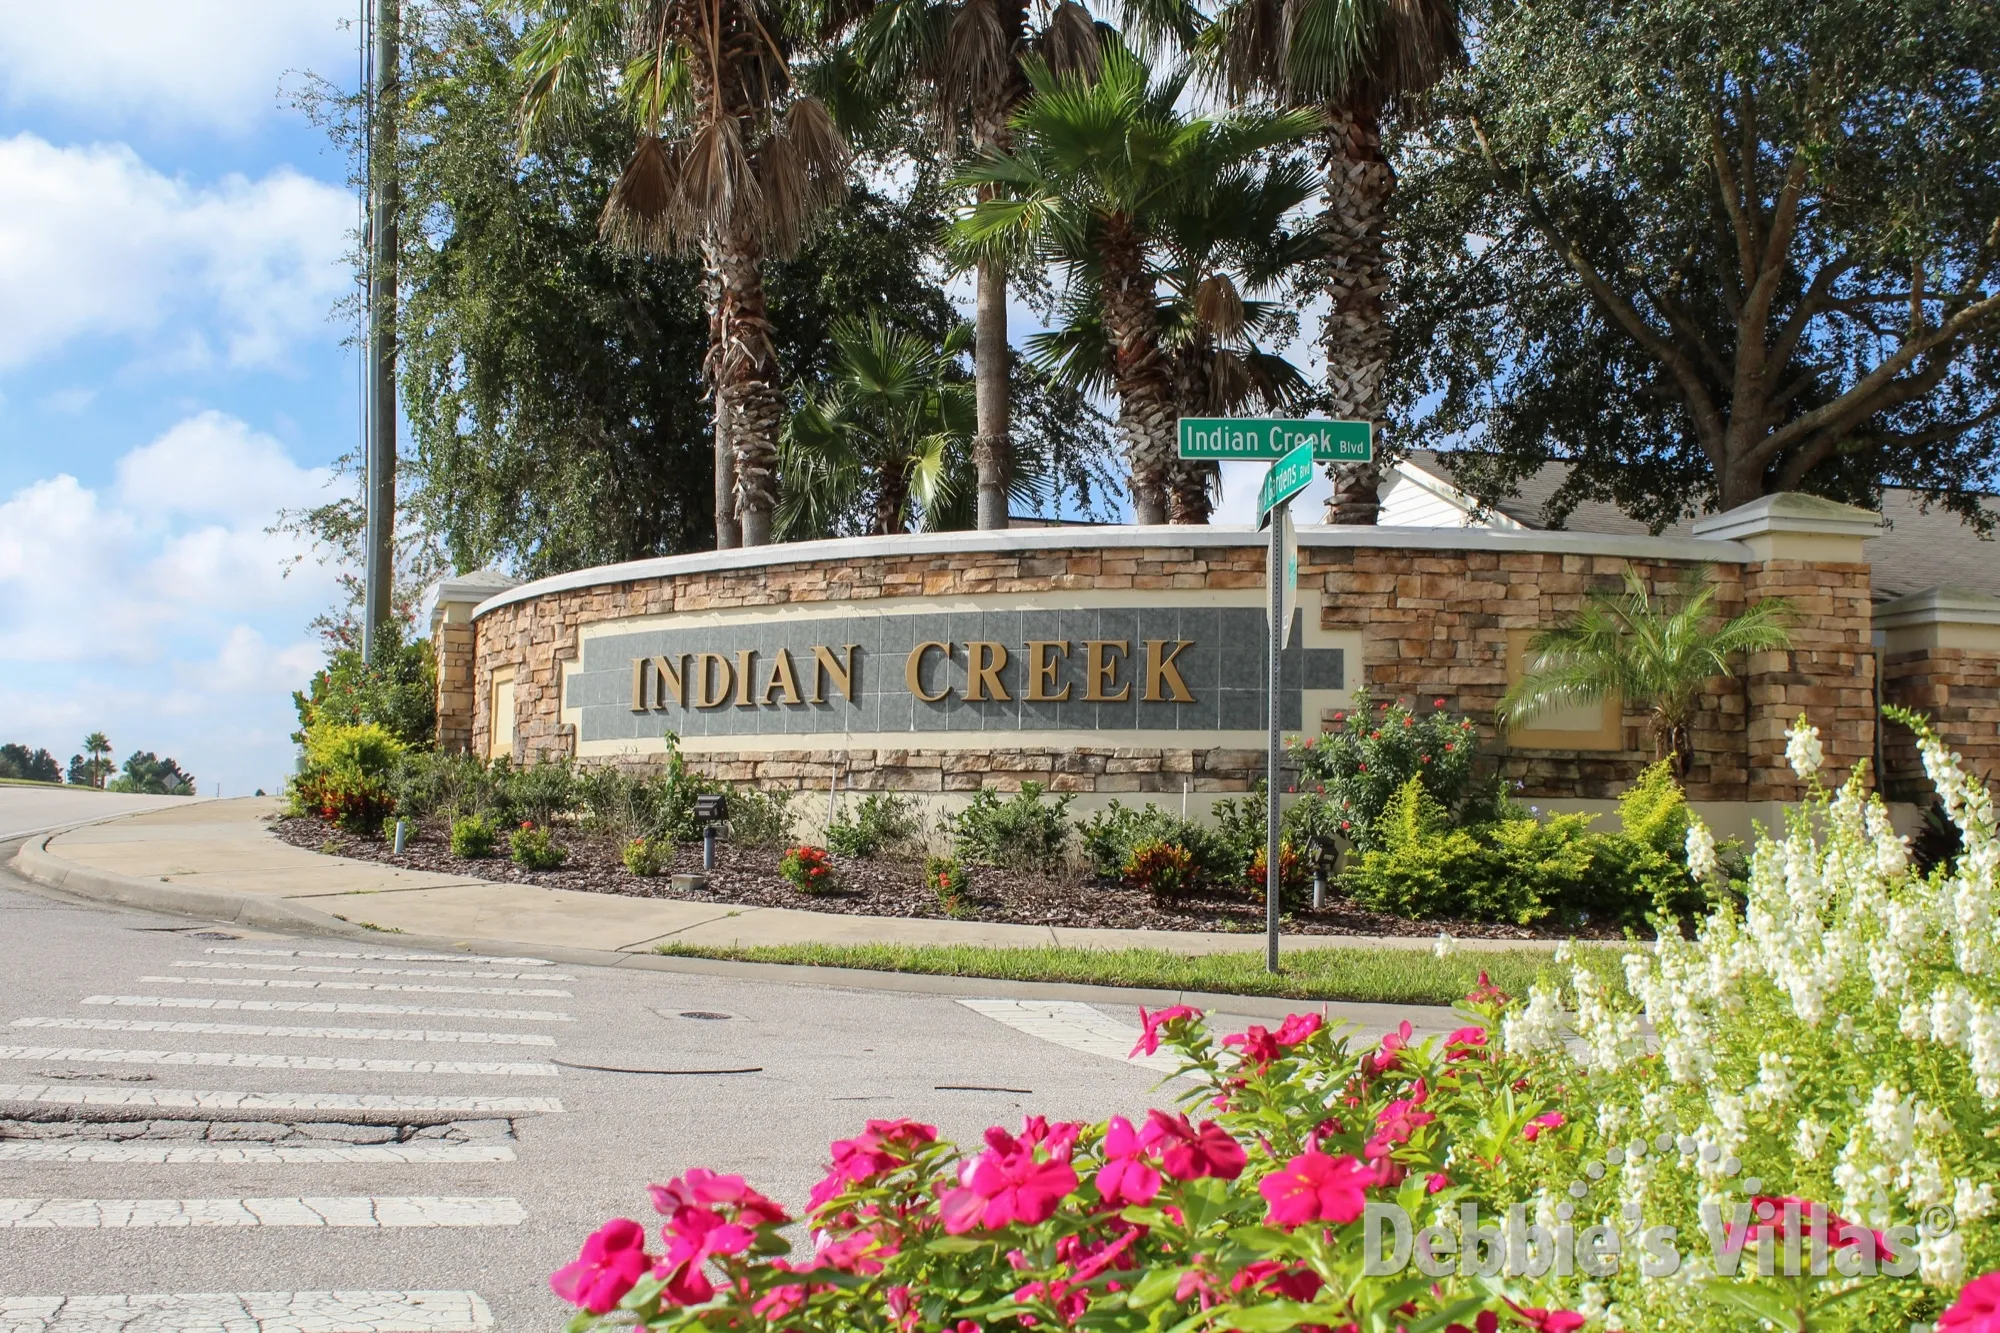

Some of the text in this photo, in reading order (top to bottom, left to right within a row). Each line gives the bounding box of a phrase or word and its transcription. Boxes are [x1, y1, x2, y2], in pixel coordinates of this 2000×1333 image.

[1187, 425, 1364, 454] Indian Creek Blvd
[1299, 463, 1311, 480] Blvd
[630, 639, 1197, 713] INDIAN CREEK
